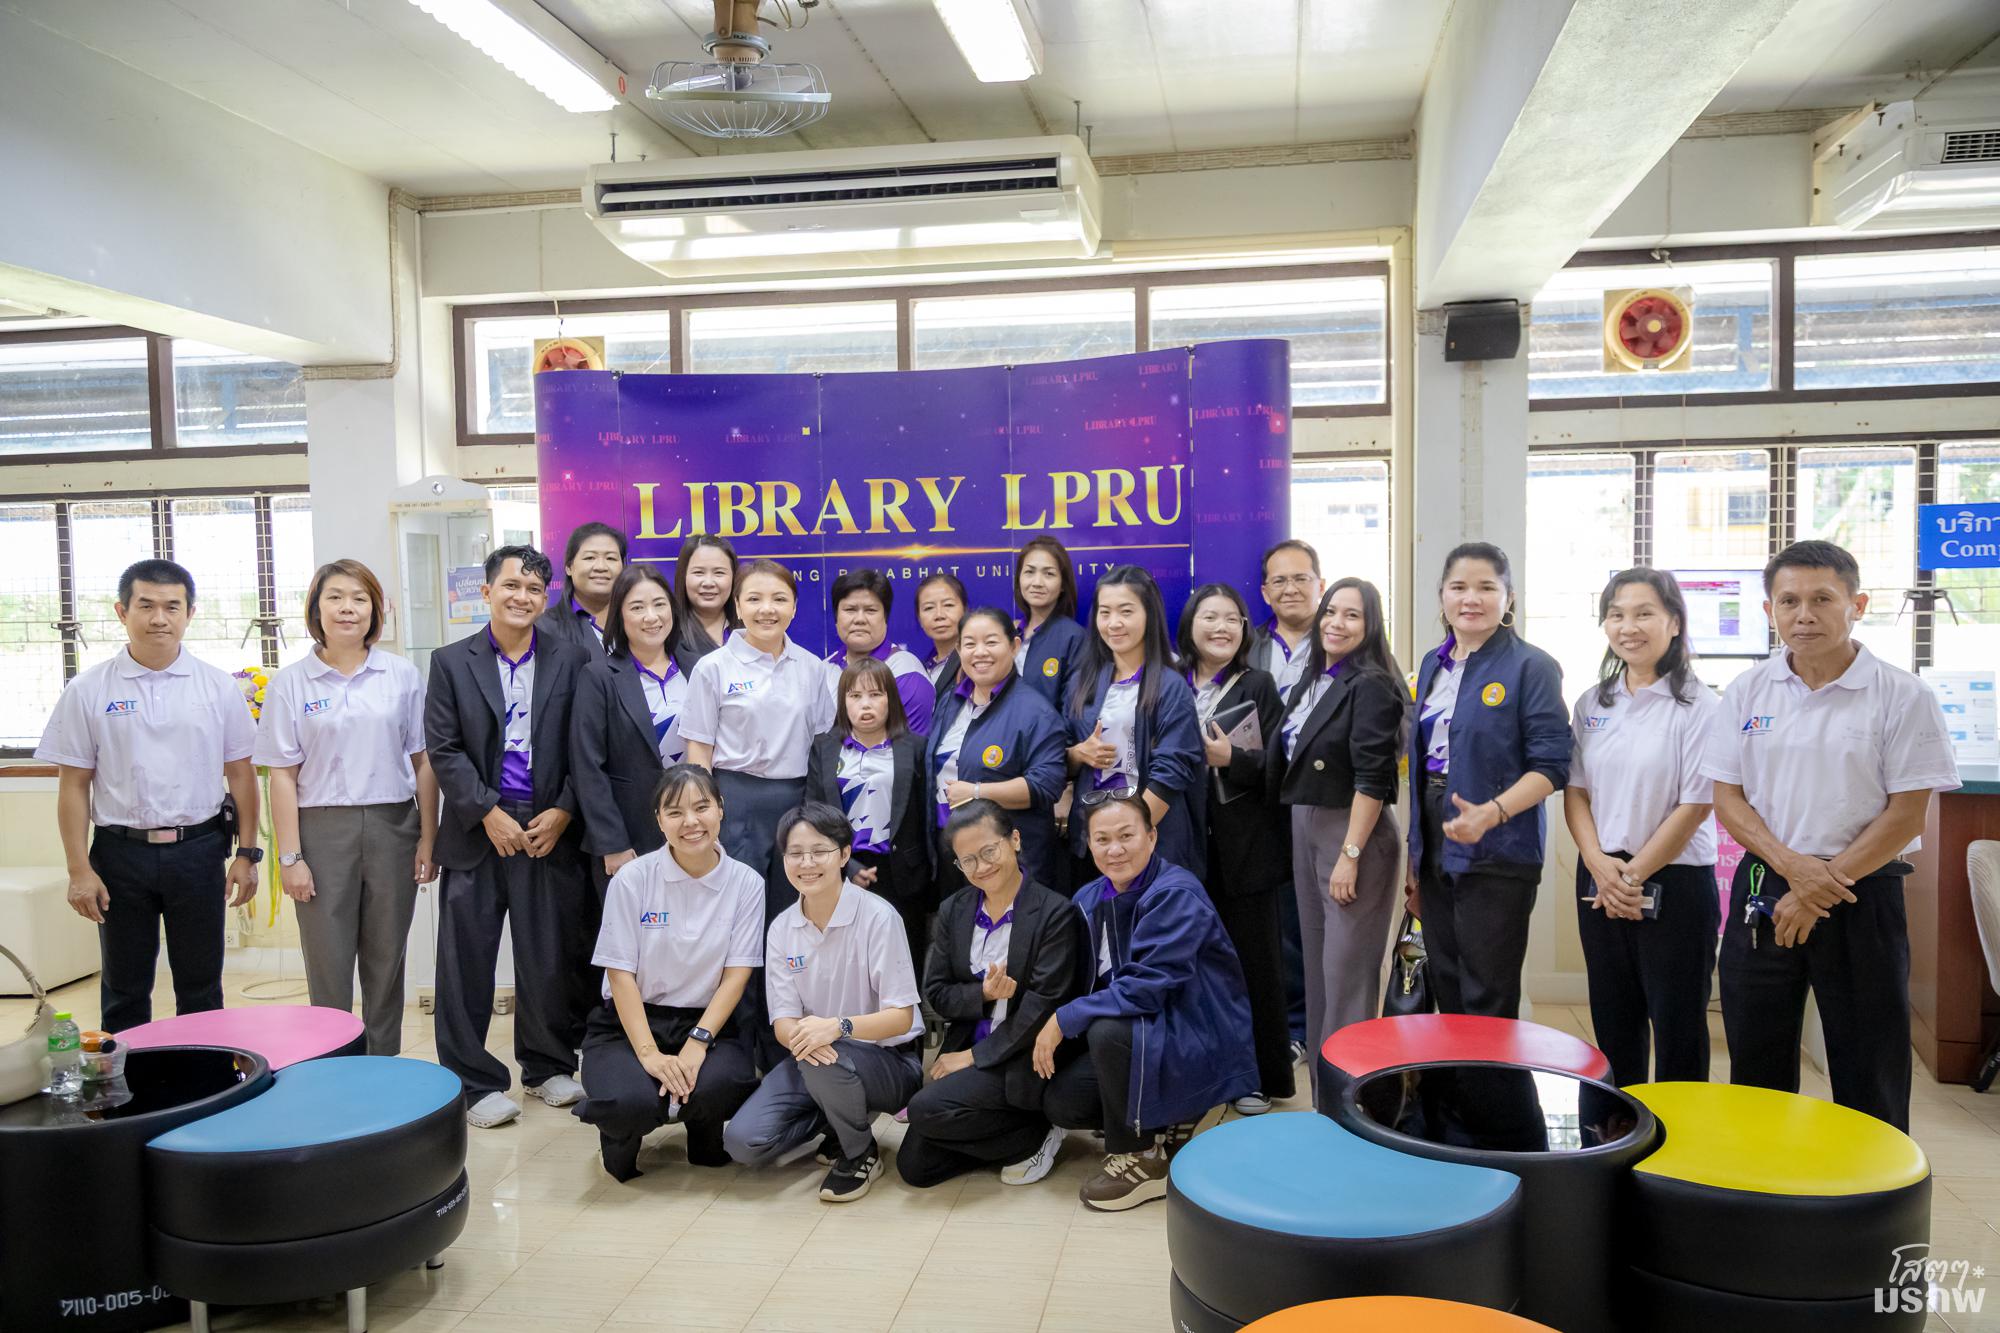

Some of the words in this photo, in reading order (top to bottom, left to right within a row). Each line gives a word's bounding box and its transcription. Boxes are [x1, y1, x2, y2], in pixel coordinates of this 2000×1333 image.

[632, 475, 966, 540] LIBRARY
[1001, 463, 1185, 530] LPRU
[1940, 540, 2000, 561] Com
[976, 562, 1115, 578] UNIITY
[727, 681, 754, 693] ARIT
[105, 700, 137, 713] ARIT
[304, 698, 330, 713] ARIT
[1742, 716, 1776, 731] ARIT
[640, 911, 670, 923] ARIT
